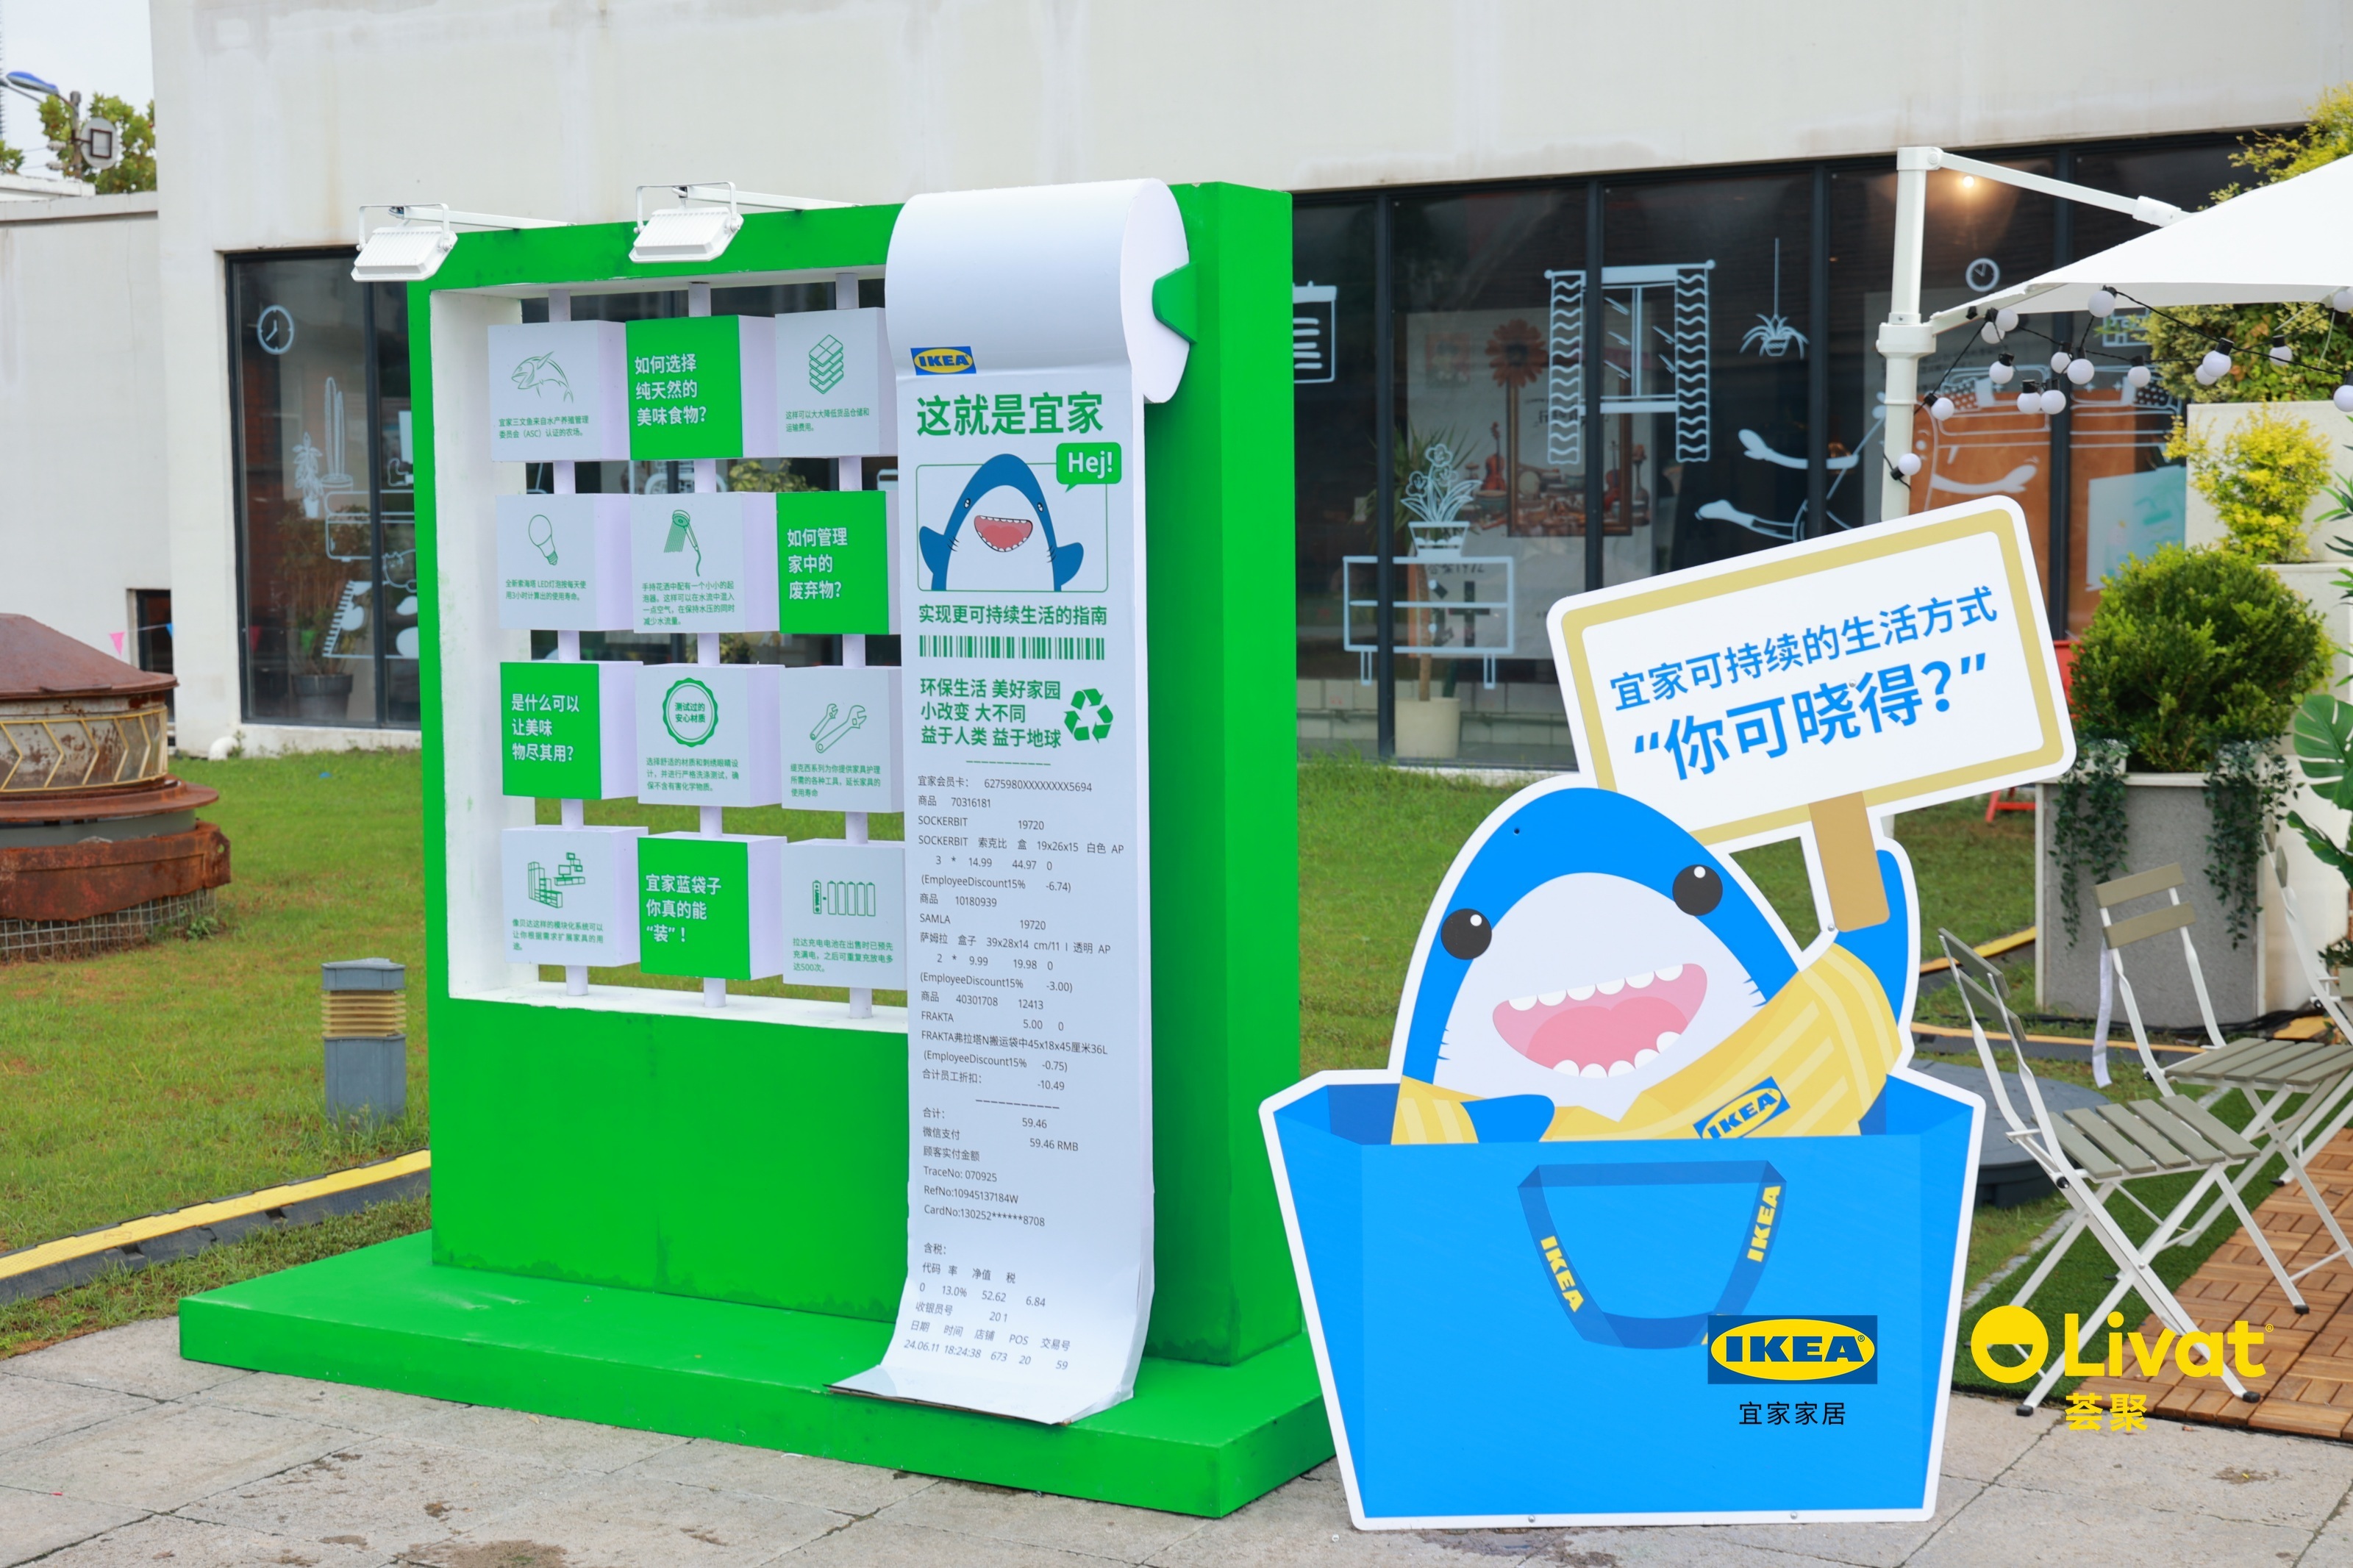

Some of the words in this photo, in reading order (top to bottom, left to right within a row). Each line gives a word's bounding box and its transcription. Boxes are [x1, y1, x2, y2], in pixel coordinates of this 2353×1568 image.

[634, 353, 697, 375] 如何选择
[918, 354, 969, 367] IKEA
[635, 379, 698, 401] 纯天然的
[499, 415, 589, 427] 宜家三文鱼来自水产养殖管理
[637, 405, 707, 427] 美味食物?
[916, 390, 1104, 437] 这就是宜家
[786, 423, 815, 432] 运输费用。
[1068, 450, 1114, 480] Hej!
[787, 526, 848, 548] 如何管理
[788, 554, 834, 574] 家中的
[642, 581, 735, 592] 手持花洒中配有一个小小的起
[788, 580, 843, 601] 废弃物?
[918, 604, 1107, 626] 实现更可持续生活的指南
[1610, 585, 1998, 712] 宜家可持续的生活方式
[920, 677, 987, 698] 环保生活
[991, 679, 1061, 700] 美好家园
[511, 693, 580, 714] 是什么可以
[674, 702, 706, 712] 测试过的
[921, 701, 970, 722] 小改变
[974, 703, 1026, 723] 大不同
[511, 717, 553, 737] 让美味
[675, 713, 706, 723] 安心材质
[921, 725, 988, 746] 益于人类
[992, 727, 1062, 748] 益于地球
[512, 742, 575, 763] 物尽其用?
[791, 788, 818, 798] 使用寿命
[918, 795, 937, 806] 商品
[951, 797, 991, 808] 70316181
[918, 815, 968, 826] SOCKERBIT
[1018, 820, 1044, 830] 19720
[918, 835, 968, 846] SOCKERBIT
[978, 837, 1007, 849] 索克比
[1018, 839, 1027, 850] 盒
[1037, 841, 1079, 852] 19x26x15
[1087, 842, 1107, 854] 白色
[1111, 844, 1124, 854] AP
[935, 855, 942, 864] 3
[968, 857, 992, 867] 14.99
[1012, 860, 1037, 870] 44.97
[645, 873, 721, 895] 宜家蓝袋子
[921, 874, 1026, 889] (EmployeeDiscount15%
[1046, 881, 1071, 893] -6.74)
[646, 899, 707, 921] 你真的能
[919, 893, 938, 905] 商品
[955, 895, 997, 907] 10180939
[919, 913, 951, 925] SAMLA
[1020, 920, 1046, 931] 19720
[793, 937, 893, 951] 拉达充电电池在出售时已预先
[920, 931, 948, 945] 萨姆拉
[957, 934, 976, 946] 盒子
[986, 937, 1029, 949] 39x28x14
[1073, 942, 1093, 954] 透明
[1098, 945, 1111, 954] AP
[793, 963, 825, 973] 达500次。
[937, 953, 943, 963] 2
[969, 956, 988, 966] 9.99
[1013, 959, 1038, 970] 19.98
[920, 972, 1024, 989] (EmployeeDiscount15%
[1046, 981, 1073, 993] -3.00)
[921, 990, 940, 1003] 商品
[956, 995, 999, 1006] 40301708
[1018, 998, 1044, 1009] 12413
[921, 1011, 954, 1023] FRAKTA
[1023, 1019, 1043, 1030] 5.00
[924, 1050, 1027, 1068] (EmployeeDiscount15%
[1041, 1061, 1068, 1073] -0.75)
[1038, 1080, 1065, 1091] -10.49
[1022, 1117, 1047, 1128] 59.46
[1707, 1092, 1778, 1139] IKEA
[922, 1126, 960, 1140] 微信支付
[1029, 1138, 1054, 1149] 59.46
[1057, 1140, 1079, 1151] RMB
[923, 1145, 980, 1161] 顾客实付金额
[924, 1166, 963, 1179] TraceNo:
[965, 1170, 998, 1182] 070925
[924, 1185, 1018, 1204] RefNo:10945137184W
[1746, 1185, 1782, 1263] IKEA
[922, 1262, 941, 1275] 代码
[948, 1264, 958, 1276] 率
[972, 1267, 991, 1281] 净值
[1006, 1272, 1016, 1284] 税
[1540, 1235, 1585, 1313] IKEA
[919, 1282, 926, 1292] 0
[941, 1285, 968, 1297] 13.0%
[982, 1290, 1007, 1303] 52.62
[1026, 1296, 1046, 1307] 6.84
[915, 1301, 953, 1317] 收银员号
[910, 1320, 930, 1333] 日期
[943, 1324, 963, 1338] 时间
[974, 1328, 995, 1342] 店铺
[1009, 1333, 1029, 1345] POS
[1040, 1337, 1071, 1352] 交易号
[904, 1339, 940, 1353] 24.06.11
[944, 1345, 982, 1358] 18:24:38
[990, 1351, 1008, 1362] 673
[1018, 1355, 1032, 1365] 20
[1055, 1360, 1068, 1370] 59
